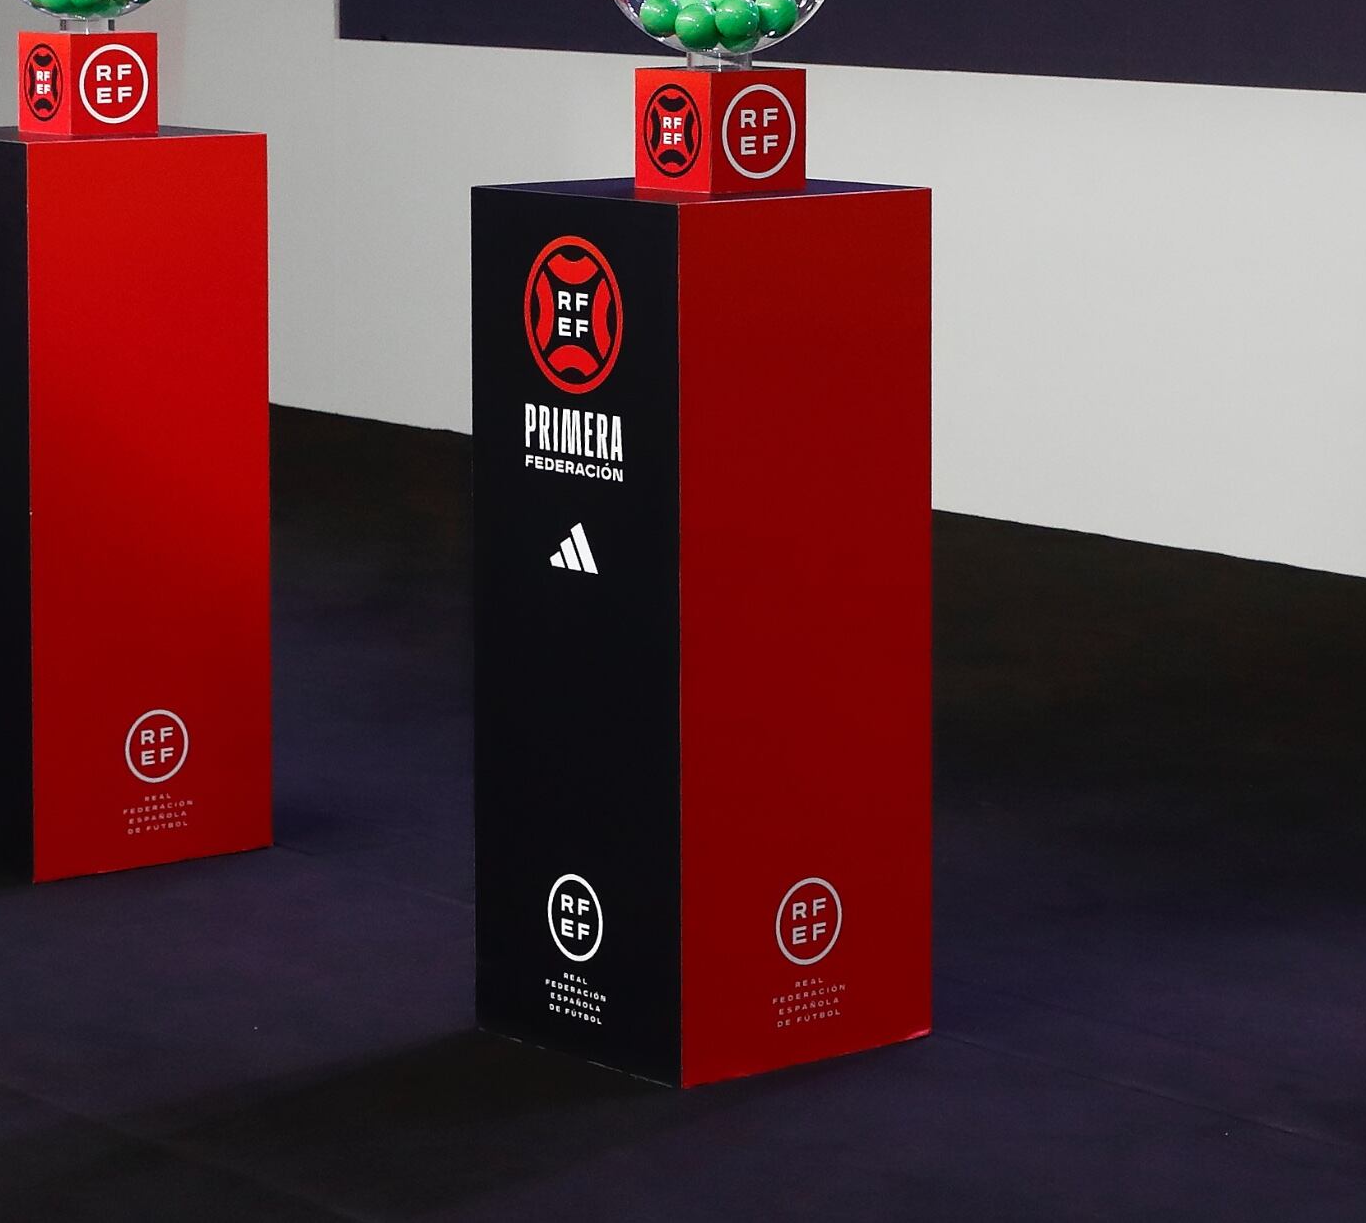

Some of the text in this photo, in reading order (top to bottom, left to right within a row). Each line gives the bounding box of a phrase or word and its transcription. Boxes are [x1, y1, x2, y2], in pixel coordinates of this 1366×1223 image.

[36, 70, 51, 82] RF
[95, 64, 132, 81] RF
[36, 84, 51, 95] EF
[96, 86, 132, 104] EF
[663, 116, 682, 129] RF
[740, 107, 779, 128] RF
[663, 132, 682, 145] EF
[740, 134, 779, 156] EF
[557, 290, 589, 311] RF
[557, 316, 589, 338] EF
[524, 402, 623, 462] PRIMERA
[525, 454, 624, 482] FEDERACIÓN
[141, 726, 174, 745] RF
[141, 747, 174, 766] EF
[561, 893, 590, 916] RF
[792, 897, 827, 920] RF
[561, 917, 590, 940] EF
[792, 922, 827, 945] EF
[563, 972, 588, 985] REAL
[795, 977, 824, 988] REAL
[545, 978, 606, 1002] FEDERACIÓN
[550, 991, 601, 1012] ESPAÑOLA
[778, 996, 839, 1016] ESPAÑOLA
[549, 1003, 602, 1025] DE FÚTBOL
[777, 1018, 791, 1028] DE
